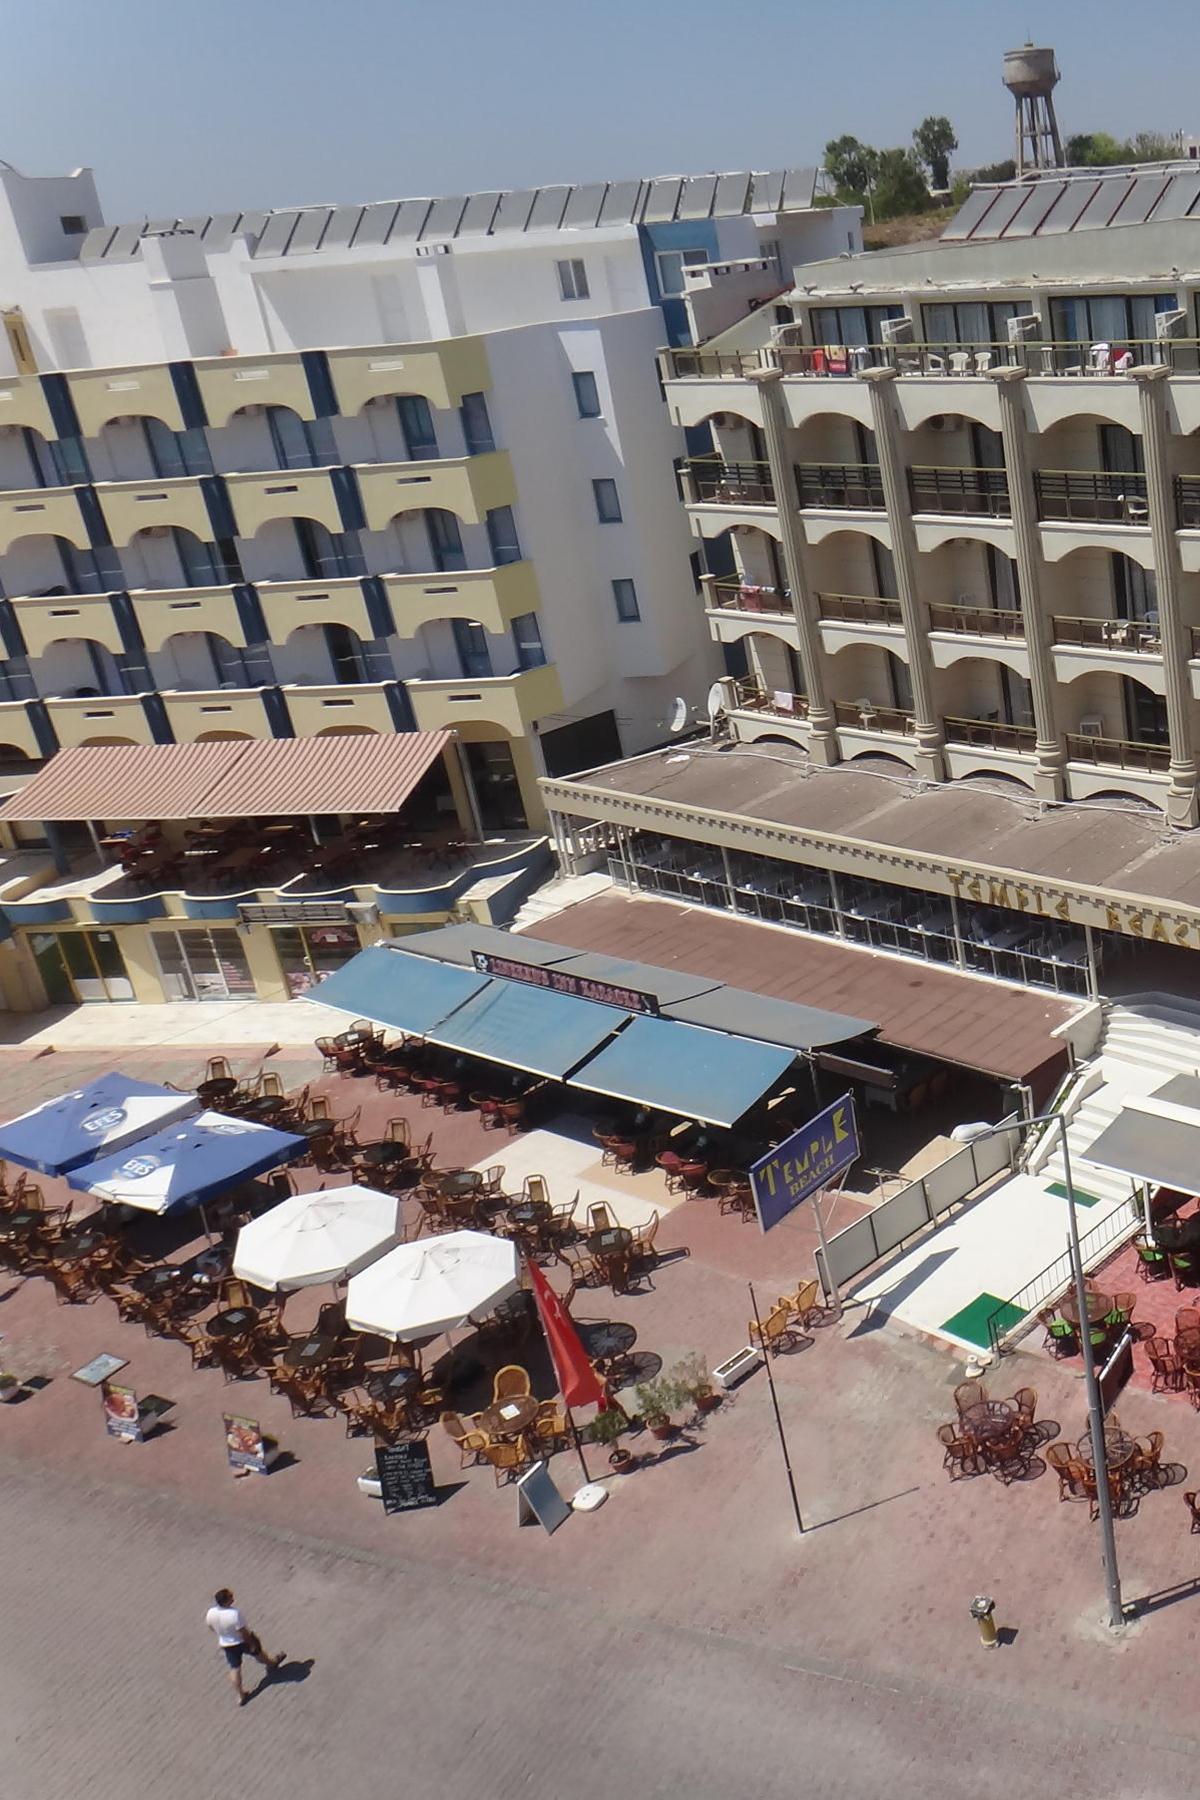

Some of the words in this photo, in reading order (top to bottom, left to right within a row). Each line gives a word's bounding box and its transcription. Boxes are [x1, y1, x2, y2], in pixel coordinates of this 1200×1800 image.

[948, 873, 1071, 921] TEMPLE
[83, 1109, 123, 1131] EFES
[789, 1153, 834, 1197] BEACH
